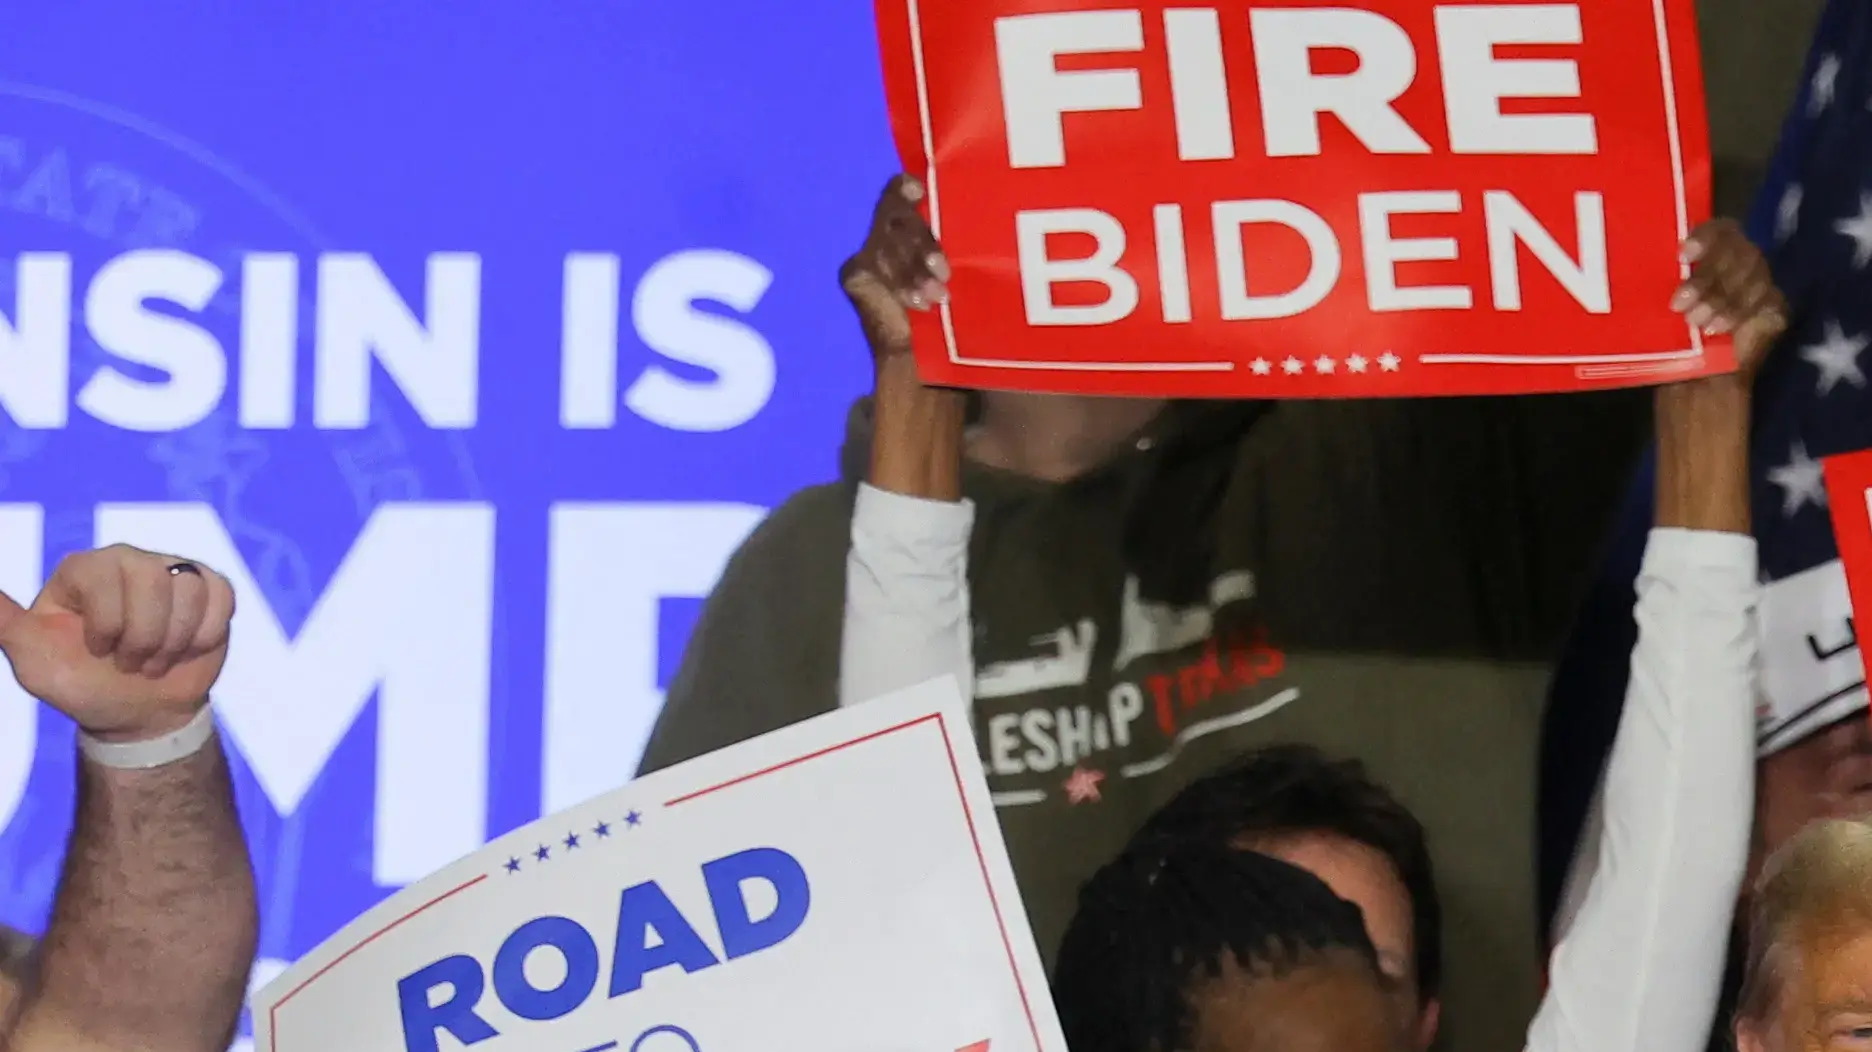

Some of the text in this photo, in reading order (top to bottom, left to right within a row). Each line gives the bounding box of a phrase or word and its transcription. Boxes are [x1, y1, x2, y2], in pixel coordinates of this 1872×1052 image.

[994, 3, 1598, 168] FIRE
[1015, 190, 1611, 327] BIDEN
[559, 248, 776, 432] IS
[982, 682, 1144, 776] ESHIP
